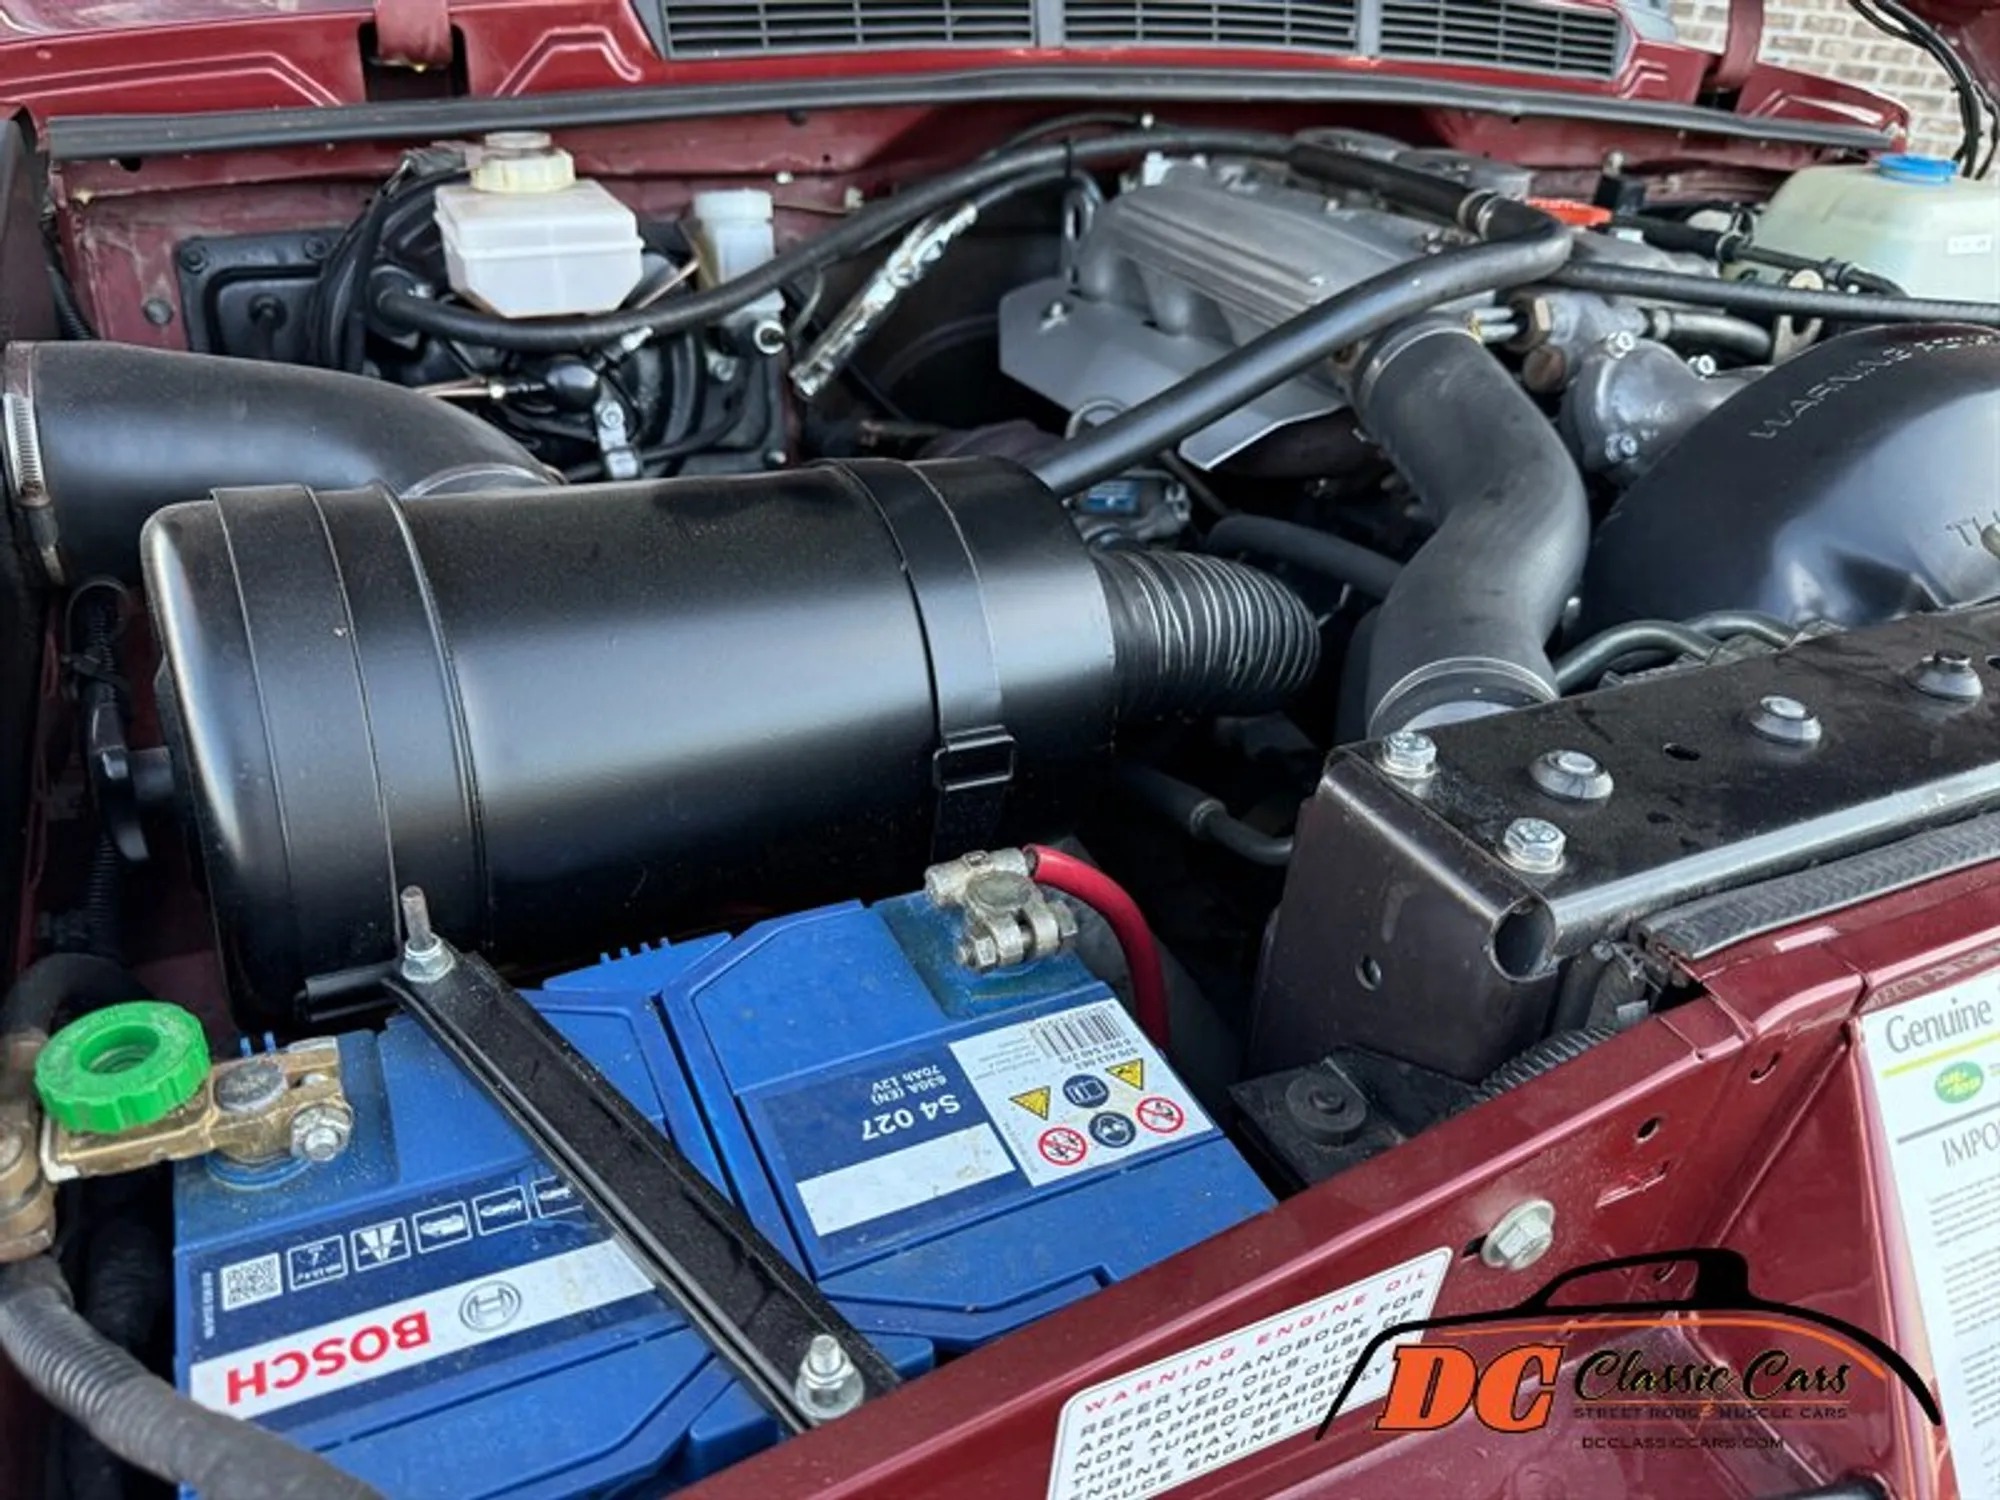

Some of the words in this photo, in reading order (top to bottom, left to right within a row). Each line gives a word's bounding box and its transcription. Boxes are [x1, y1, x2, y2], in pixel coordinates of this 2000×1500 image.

[1886, 997, 1994, 1054] Genuine
[872, 1076, 900, 1093] 12V
[919, 1094, 961, 1121] S4
[862, 1107, 914, 1141] 027
[1941, 1118, 2000, 1168] IMPO
[226, 1310, 431, 1405] BOSCH
[1080, 1394, 1171, 1438] REFER
[1180, 1377, 1211, 1397] TO
[1218, 1314, 1364, 1382] HANDBOOK
[1377, 1289, 1424, 1315] FOR
[1084, 1347, 1236, 1413] WARNING
[1257, 1294, 1368, 1346] ENGINE
[1385, 1269, 1428, 1292] OIL
[1074, 1440, 1134, 1473] NON
[1148, 1376, 1291, 1443] APPROVED
[1305, 1346, 1359, 1377] OILS
[1077, 1387, 1228, 1455] APPROVED
[1323, 1326, 1371, 1354] USE
[1183, 1428, 1237, 1456] MAY
[1252, 1363, 1385, 1429] SERIOULY
[1187, 1422, 1281, 1471] ENGINE
[1294, 1401, 1334, 1425] LIF
[1073, 1457, 1133, 1488] THIS
